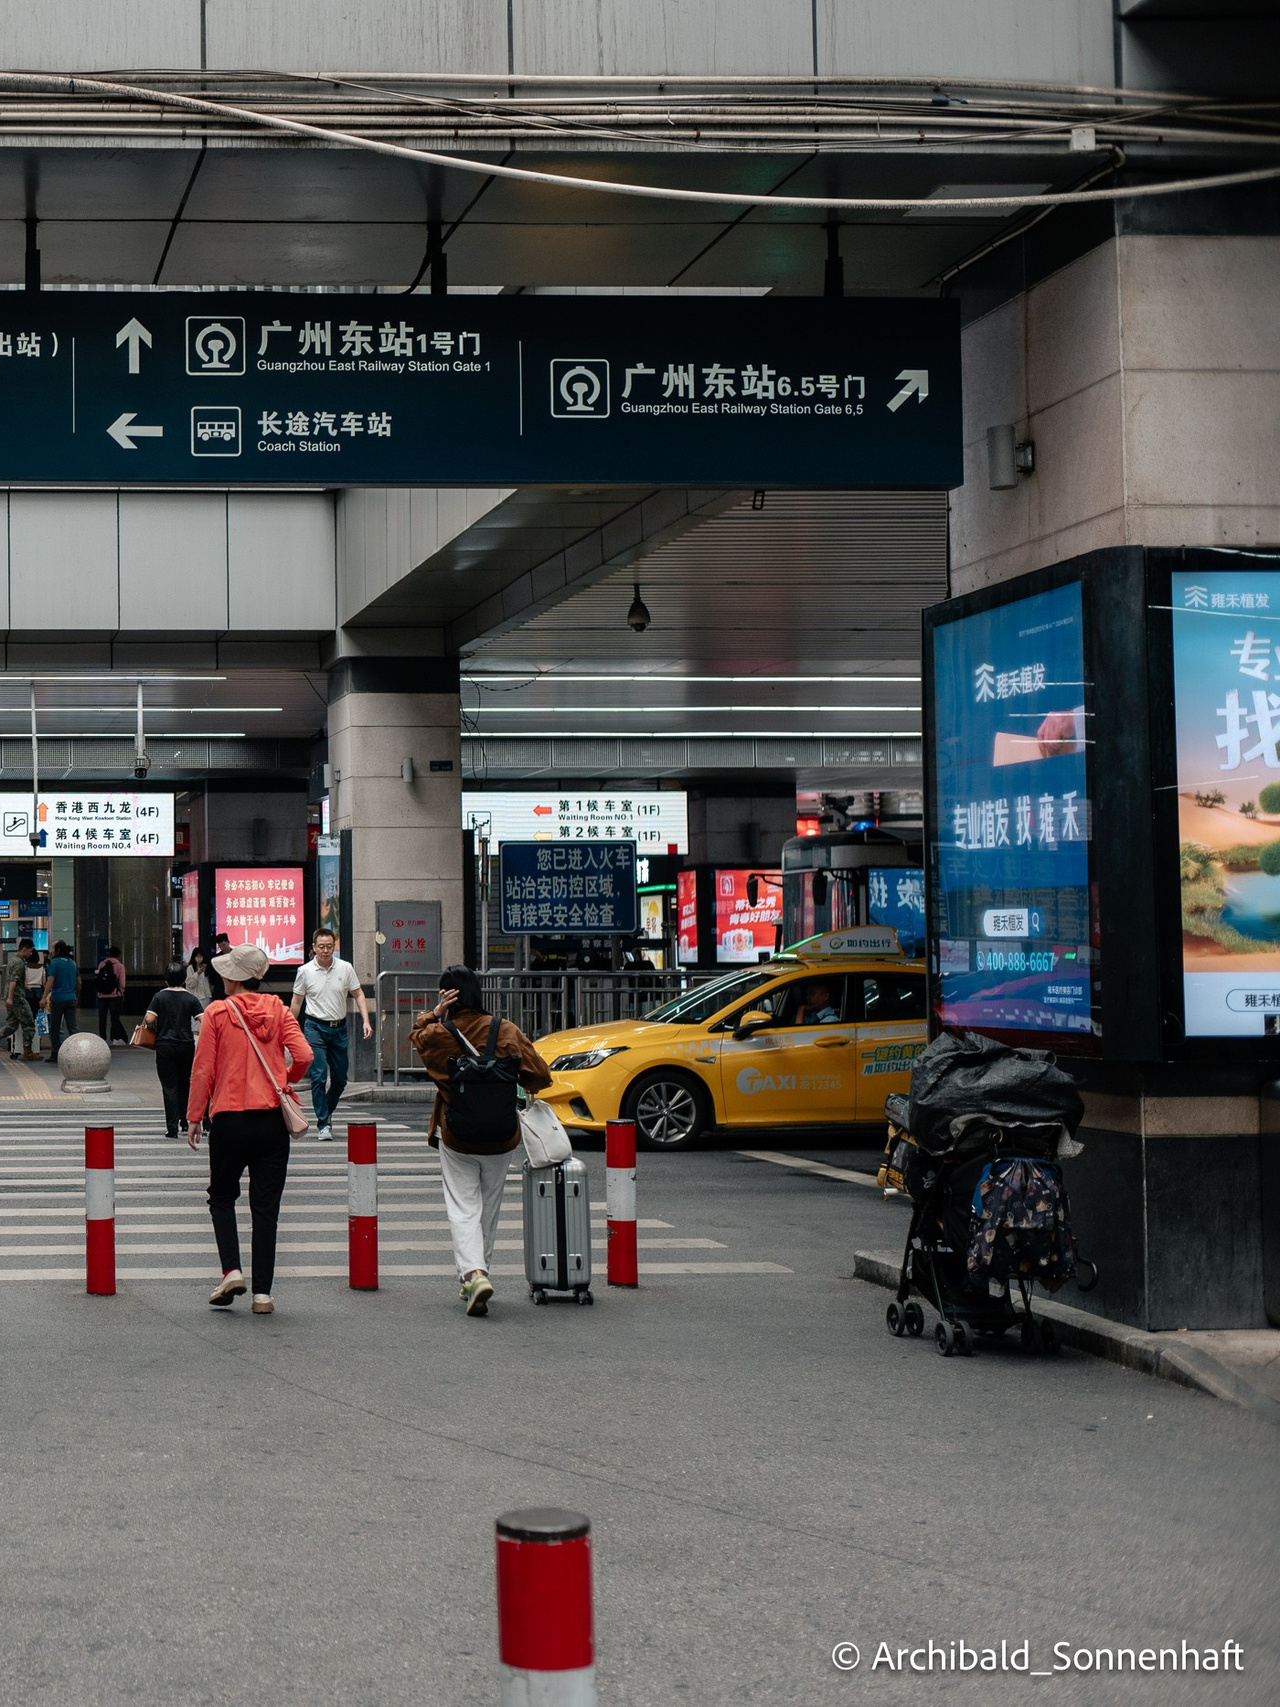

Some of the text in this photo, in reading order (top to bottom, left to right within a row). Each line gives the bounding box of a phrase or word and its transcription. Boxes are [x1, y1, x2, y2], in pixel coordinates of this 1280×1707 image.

[257, 320, 482, 358] 广州东站1号门
[257, 360, 491, 374] Guangzhou East Railway Station Gate 1
[621, 402, 688, 415] Guangzhou
[691, 402, 718, 414] East
[721, 402, 766, 416] Railway
[769, 402, 811, 414] Station
[813, 402, 842, 414] Gate
[257, 410, 392, 438] 长途汽车站
[257, 441, 341, 452] Coach Station
[1211, 593, 1269, 608] 雍禾植发
[1230, 631, 1280, 681] 专
[996, 662, 1046, 700] 雍禾植发
[55, 801, 160, 819] 香港西九龙 (4F)
[558, 800, 661, 817] 第1候车室 (1F)
[558, 814, 588, 822] Waiting
[953, 798, 1010, 850] 专业植发
[1016, 795, 1033, 846] 找
[1062, 790, 1080, 841] 禾
[55, 827, 132, 841] 第4候车室
[135, 832, 160, 845] (4F)
[559, 826, 661, 842] 第2候车室 (1F)
[55, 842, 86, 850] Waiting
[536, 845, 631, 870] 您已进入火车
[224, 879, 265, 891] 务必不忘初心
[993, 914, 1025, 932] 雍禾植发
[392, 938, 426, 949] 消火栓
[847, 939, 892, 948] 如约出行
[986, 951, 1055, 972] 400-888-6667
[811, 1080, 842, 1089] 12345
